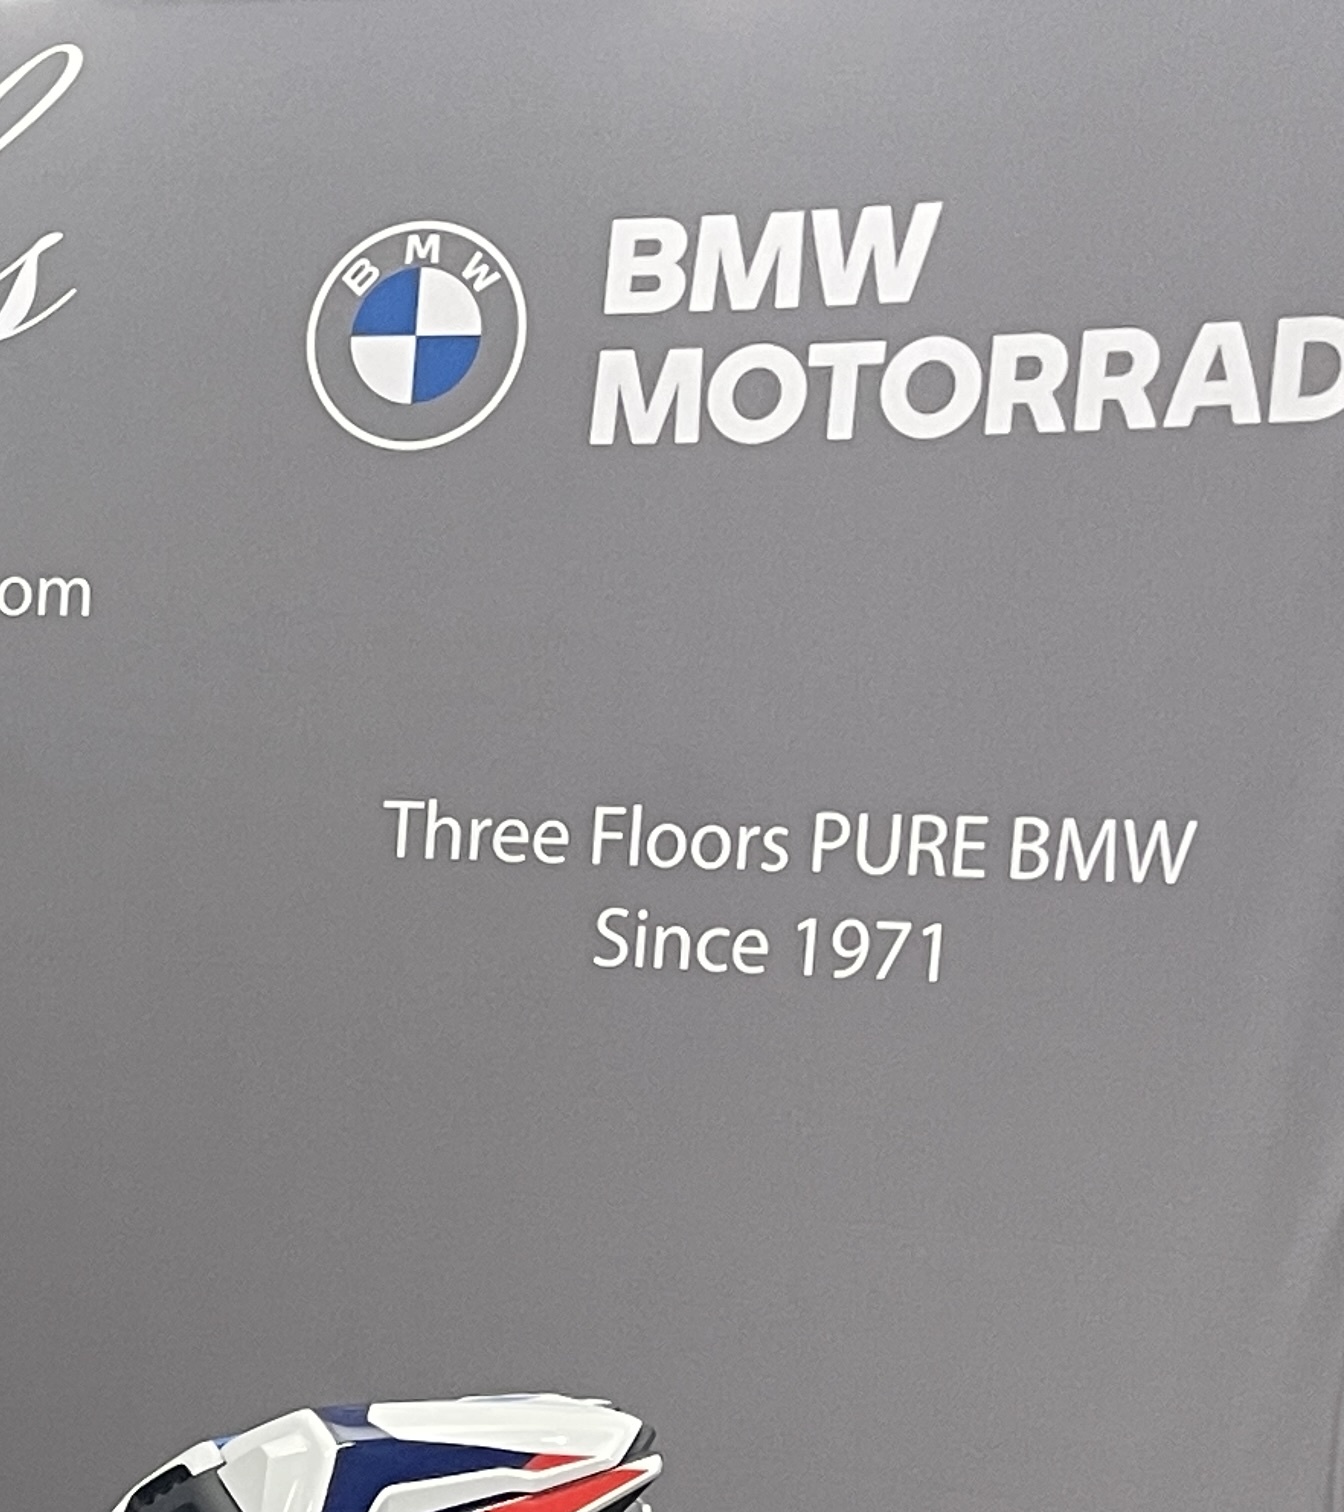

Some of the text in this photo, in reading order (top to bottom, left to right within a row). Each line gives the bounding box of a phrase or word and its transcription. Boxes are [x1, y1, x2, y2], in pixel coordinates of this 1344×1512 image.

[341, 232, 503, 297] BMW
[603, 200, 944, 315] BMW
[589, 315, 1344, 446] MOTORRAD
[383, 798, 1198, 885] Three Floors PURE BMW
[593, 907, 942, 983] Since 1971
